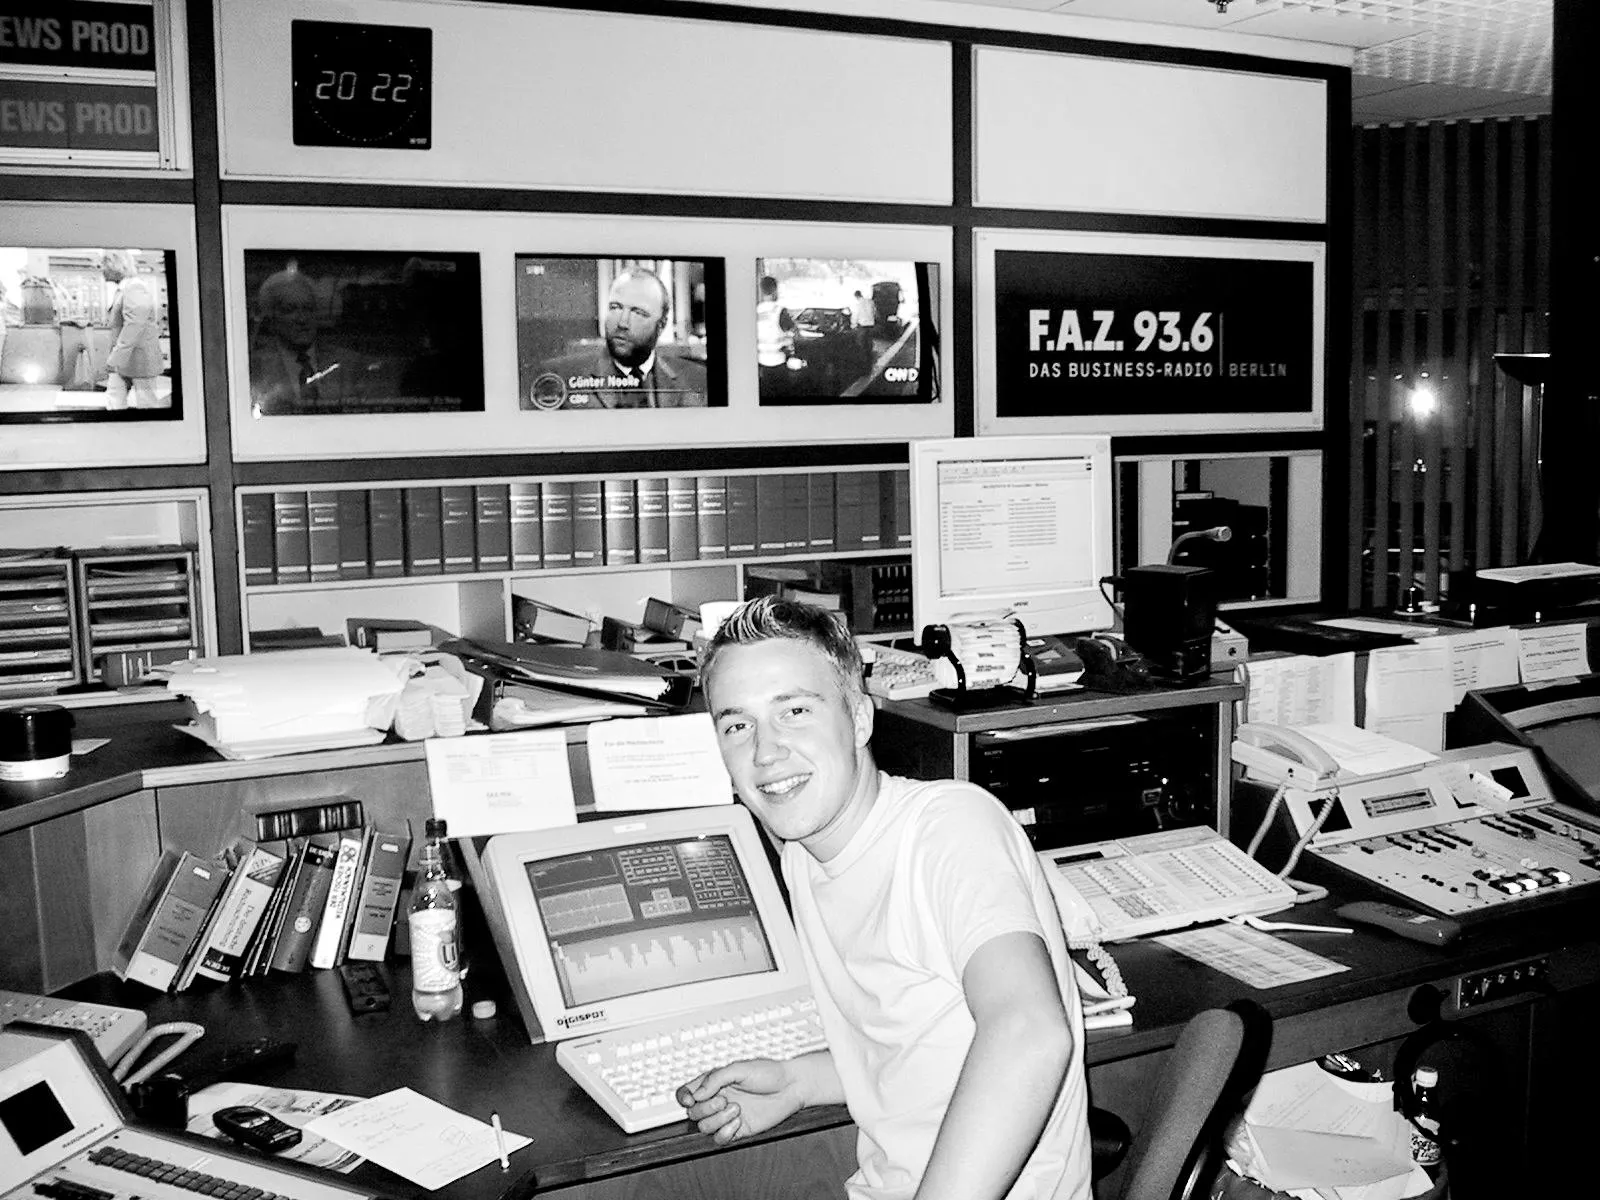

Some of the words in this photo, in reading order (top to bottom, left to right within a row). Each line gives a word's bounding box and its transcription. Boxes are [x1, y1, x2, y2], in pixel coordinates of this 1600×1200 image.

[71, 20, 149, 55] PROD
[316, 70, 357, 100] 20
[371, 73, 413, 102] 22
[75, 101, 152, 136] PROD
[1029, 309, 1124, 351] F.A.Z.
[1133, 310, 1214, 352] 93.6
[1029, 362, 1061, 378] DAS
[1068, 362, 1213, 378] BUSINESS-RADIO
[1229, 362, 1287, 377] BERLIN
[556, 1010, 605, 1029] DIGISPOT
